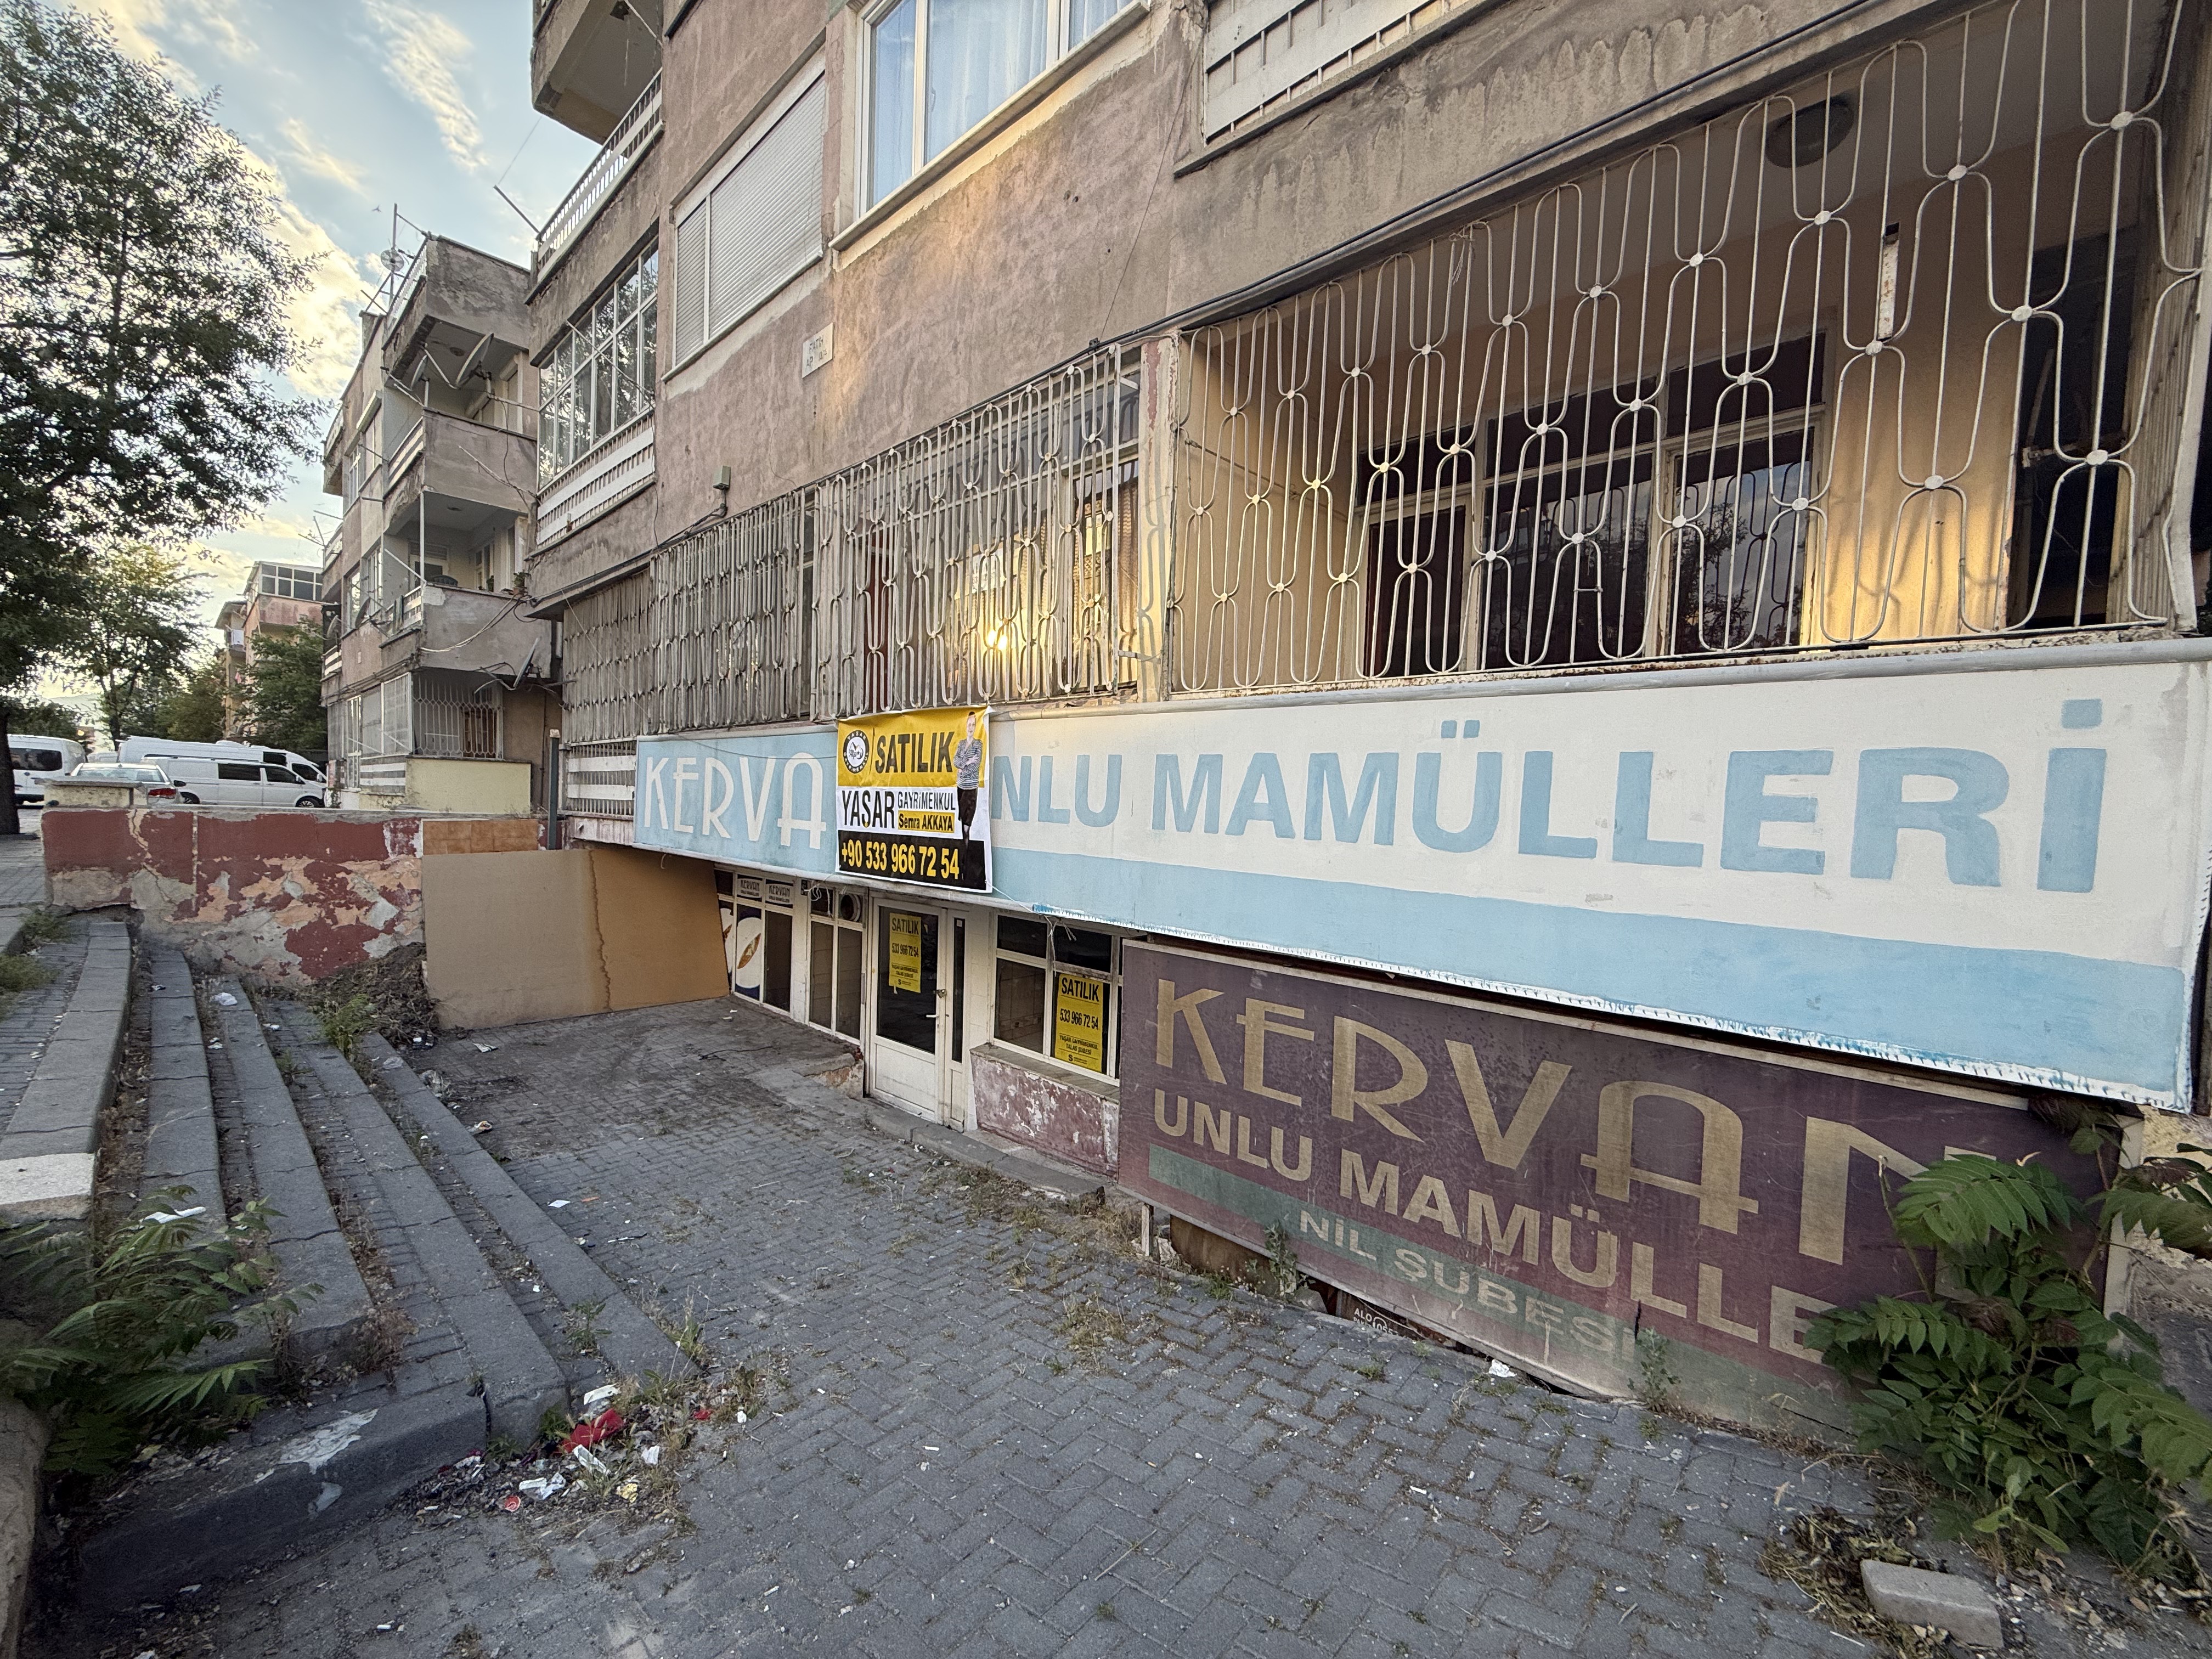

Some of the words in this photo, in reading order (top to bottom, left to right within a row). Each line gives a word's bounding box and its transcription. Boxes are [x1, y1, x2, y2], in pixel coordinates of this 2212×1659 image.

[875, 731, 955, 774] SATILIK
[644, 752, 826, 850] KERVA
[991, 754, 1122, 827] NLU
[1152, 698, 2106, 893] MAMÜLLERİ
[899, 813, 920, 829] Semra
[922, 815, 953, 831] AKKAYA
[842, 839, 862, 867] +90
[866, 842, 887, 871] 533
[891, 843, 916, 873] 966
[919, 846, 936, 877] 72
[941, 848, 960, 879] 54
[741, 880, 760, 891] KERVAN
[769, 885, 790, 898] KERVAN
[892, 918, 919, 935] SATILIK
[900, 945, 908, 956] 966
[909, 946, 913, 957] 72
[914, 946, 919, 957] 54
[1062, 977, 1099, 1002] SATILIK
[1060, 1008, 1070, 1023] 533
[1071, 1011, 1082, 1026] 966
[1083, 1014, 1091, 1028] 72
[1092, 1016, 1099, 1030] 54
[1066, 1043, 1077, 1051] TALAS
[1154, 1088, 1312, 1181] UNLU
[1299, 1210, 1376, 1261] NİL
[1394, 1248, 1634, 1361] ŞUBESİ
[1355, 1308, 1372, 1322] ALO
